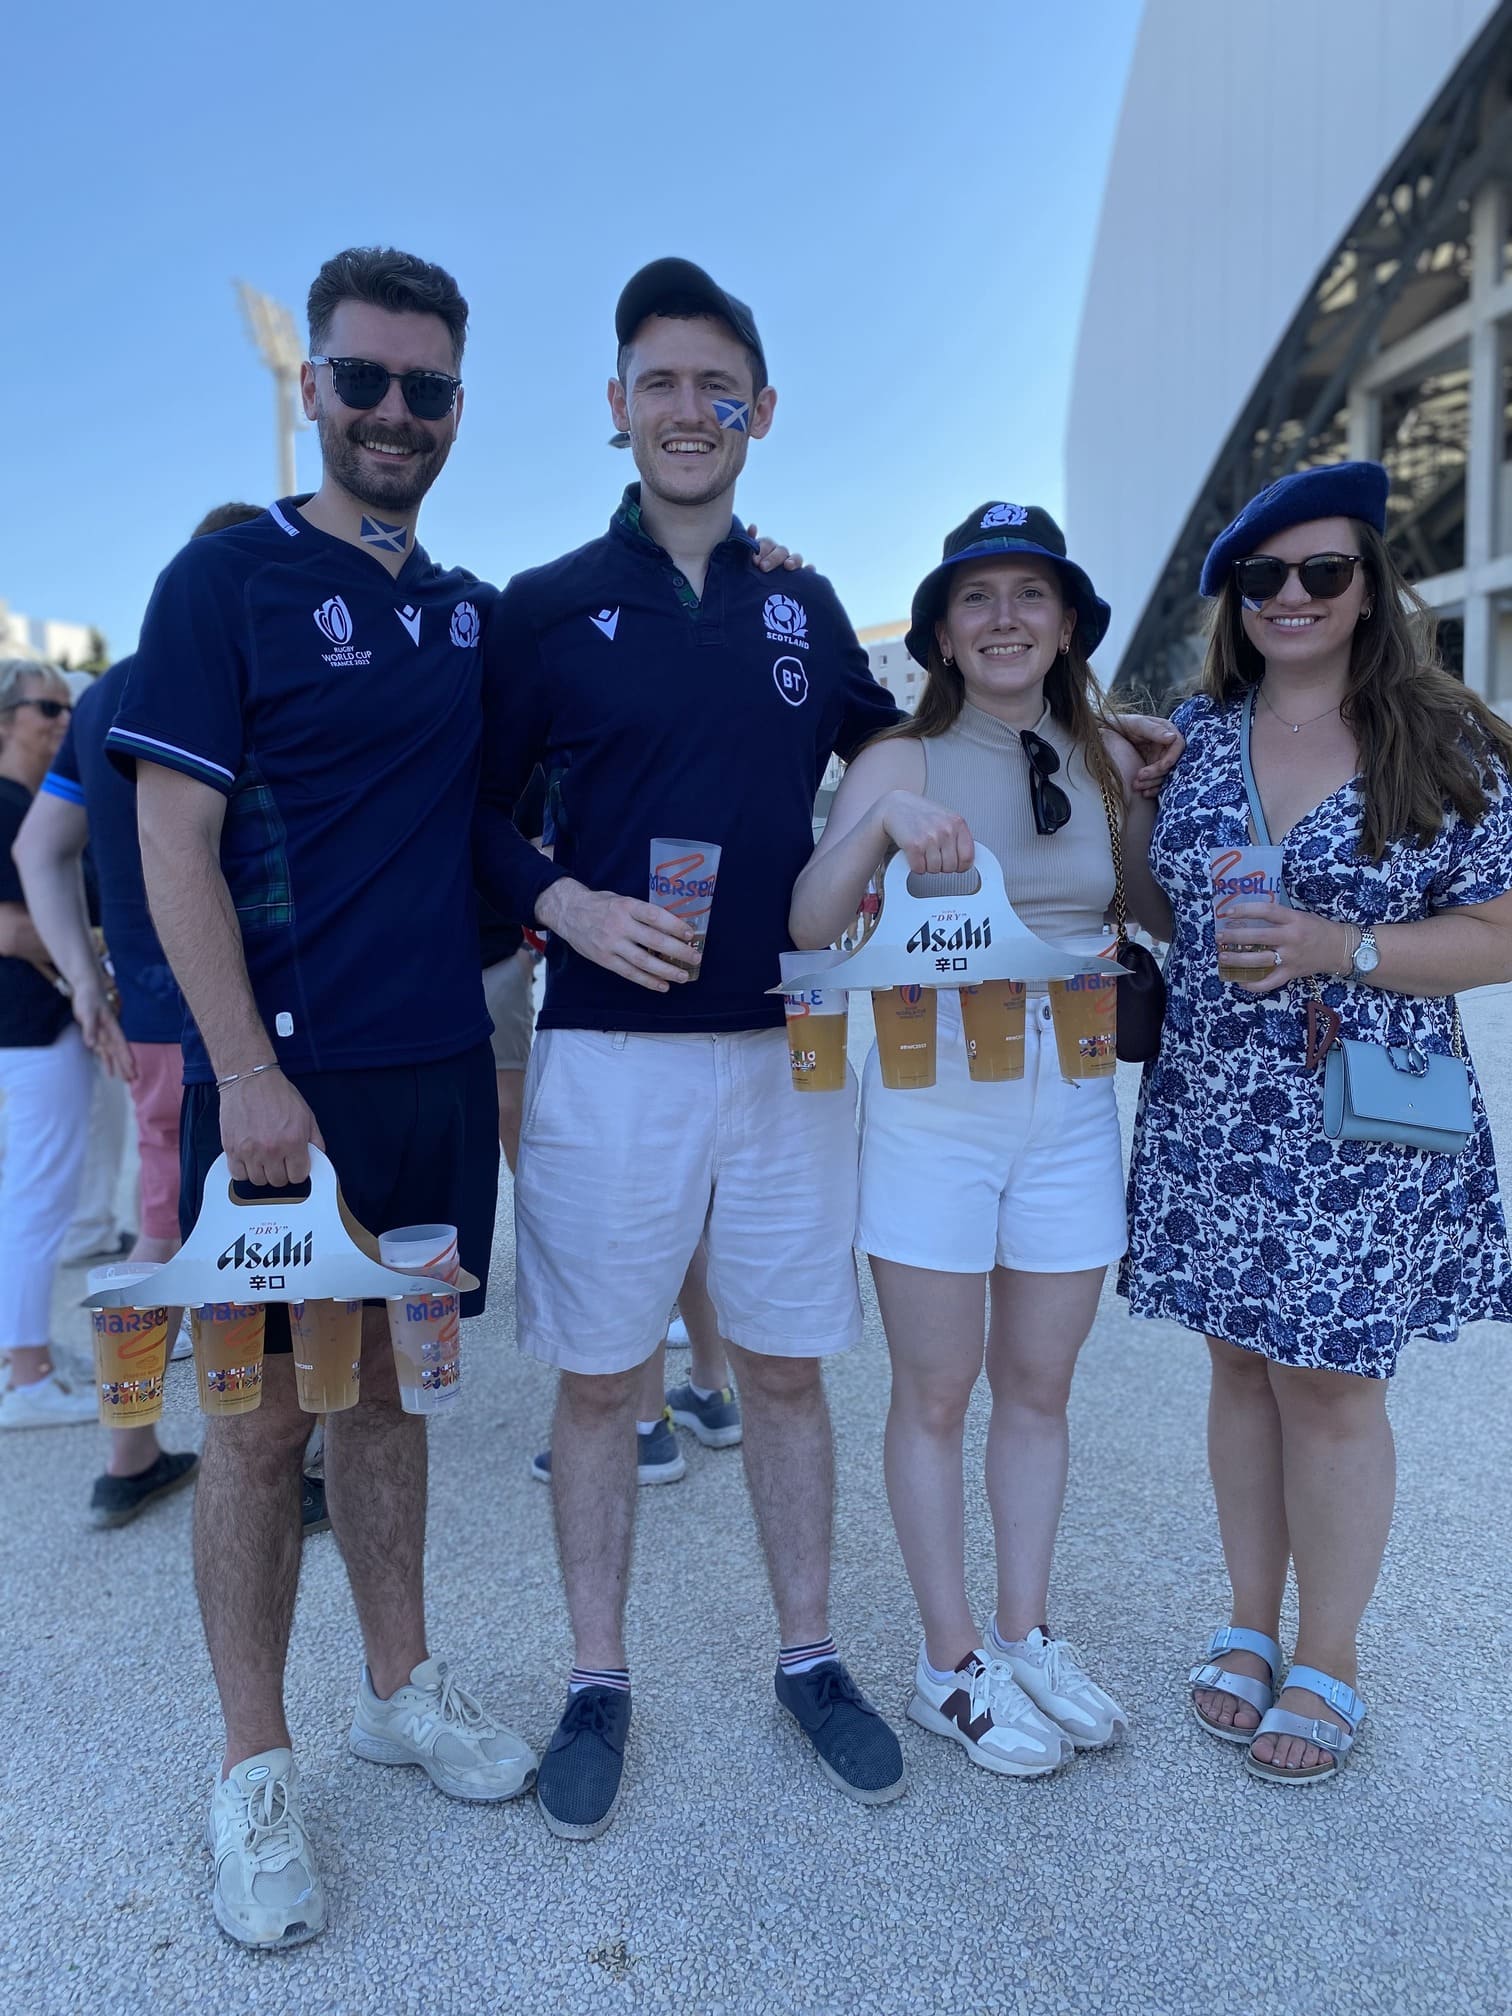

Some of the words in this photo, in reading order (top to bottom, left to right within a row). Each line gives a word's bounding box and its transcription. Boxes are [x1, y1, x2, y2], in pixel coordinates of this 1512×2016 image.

[766, 632, 809, 650] SCOTLAND
[321, 653, 355, 662] WORLD
[355, 651, 372, 659] CUP
[782, 669, 801, 692] BT
[906, 916, 992, 954] Asahi
[935, 957, 967, 973] 辛口
[217, 1230, 313, 1271] Asahi
[249, 1275, 285, 1291] 辛口
